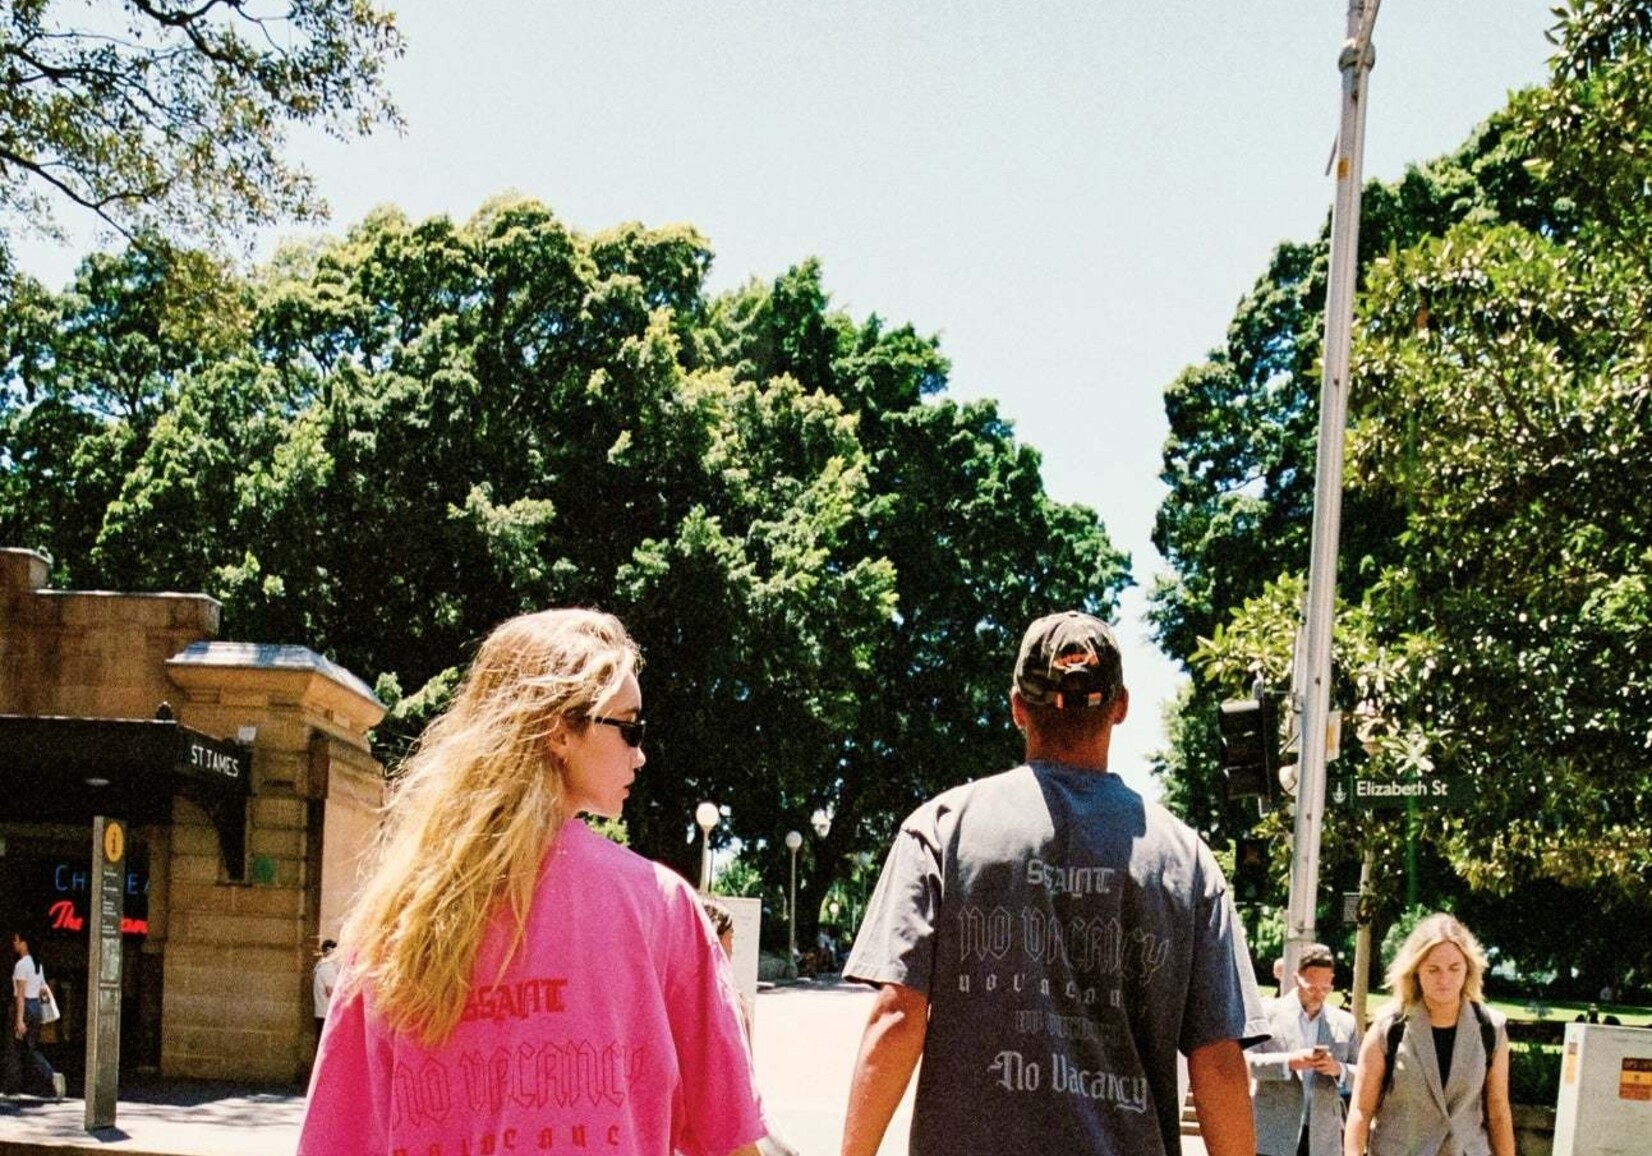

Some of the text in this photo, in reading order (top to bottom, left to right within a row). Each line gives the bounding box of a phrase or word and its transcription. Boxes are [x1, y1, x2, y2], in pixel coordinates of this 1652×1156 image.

[190, 744, 239, 778] ST JAMES
[1356, 779, 1448, 796] Elizabeth St
[987, 1050, 1147, 1114] No Vacancy
